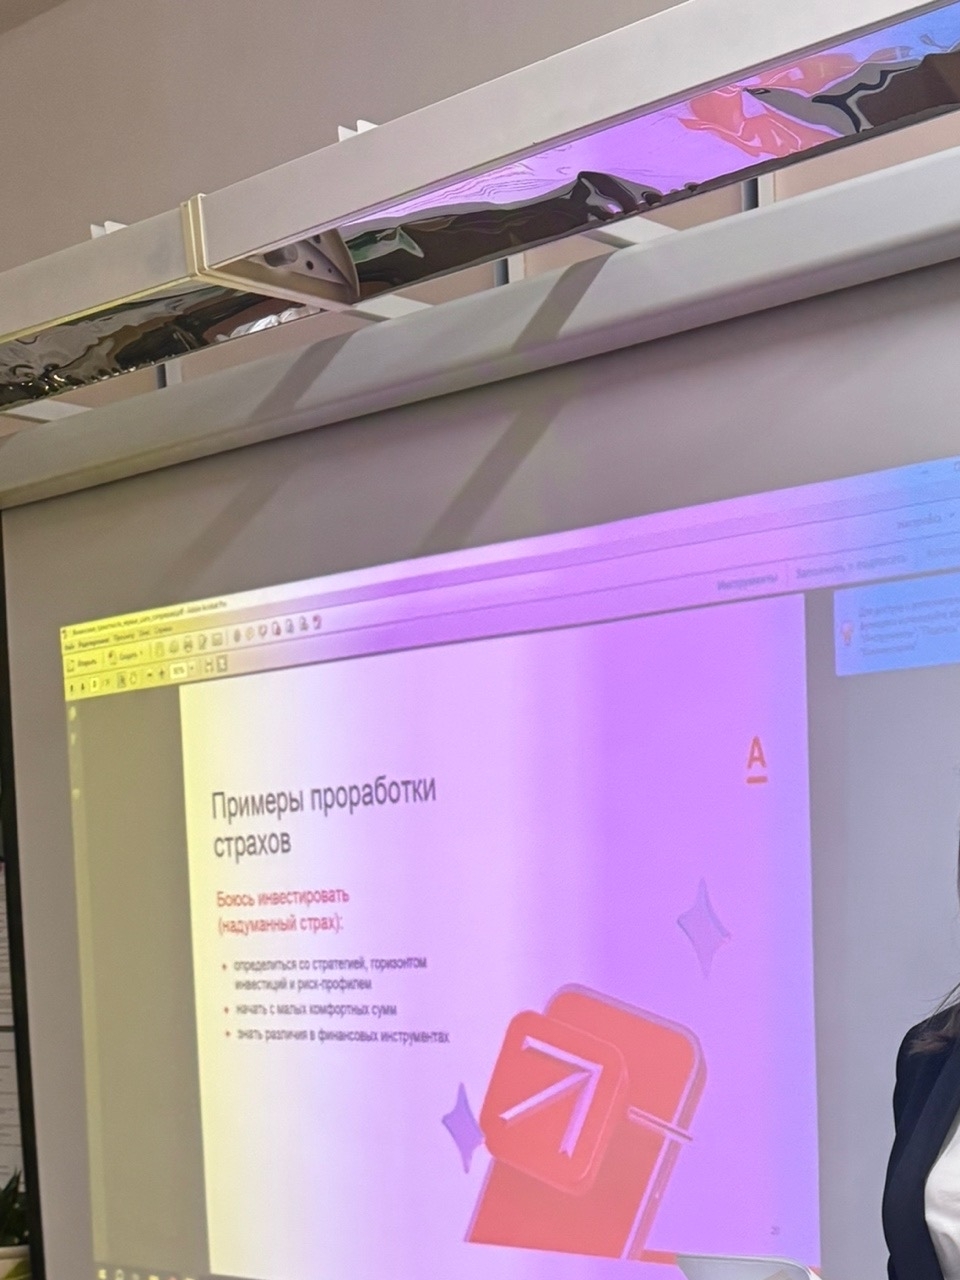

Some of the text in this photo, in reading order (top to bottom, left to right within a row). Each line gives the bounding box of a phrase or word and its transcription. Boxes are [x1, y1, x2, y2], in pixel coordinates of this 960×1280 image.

[211, 775, 437, 824] Примеры проработки
[214, 831, 291, 863] страхов
[216, 887, 350, 907] Боюсь инвестировать
[218, 912, 344, 936] (надуманный страх):
